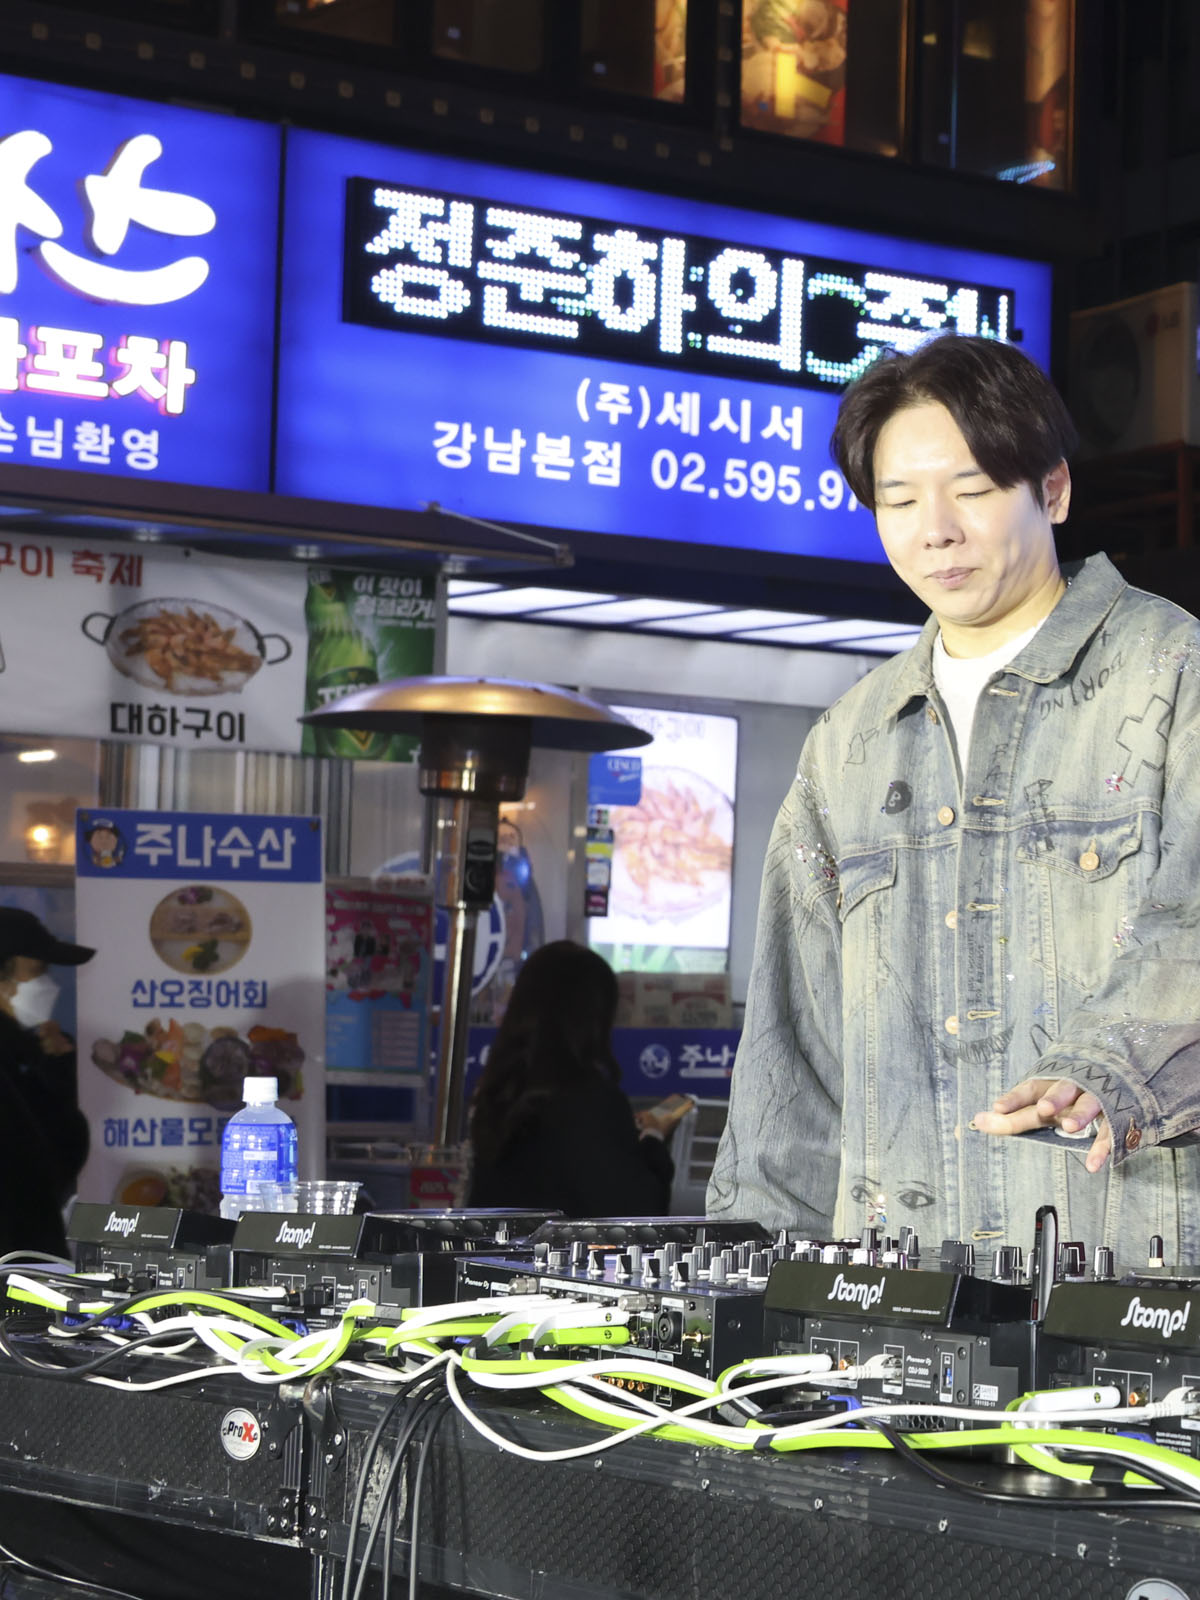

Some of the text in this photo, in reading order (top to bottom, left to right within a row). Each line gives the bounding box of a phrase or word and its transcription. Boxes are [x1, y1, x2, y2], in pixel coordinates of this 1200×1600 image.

[433, 420, 858, 511] 강남본점 02.595.9
[72, 550, 143, 587] 축제
[110, 701, 246, 743] 대하구이
[135, 822, 296, 870] 주나수산
[131, 980, 268, 1009] 산오징어회
[104, 1117, 223, 1148] 해산물모
[827, 1273, 886, 1310] Stomp!
[1120, 1296, 1191, 1338] Stomp!
